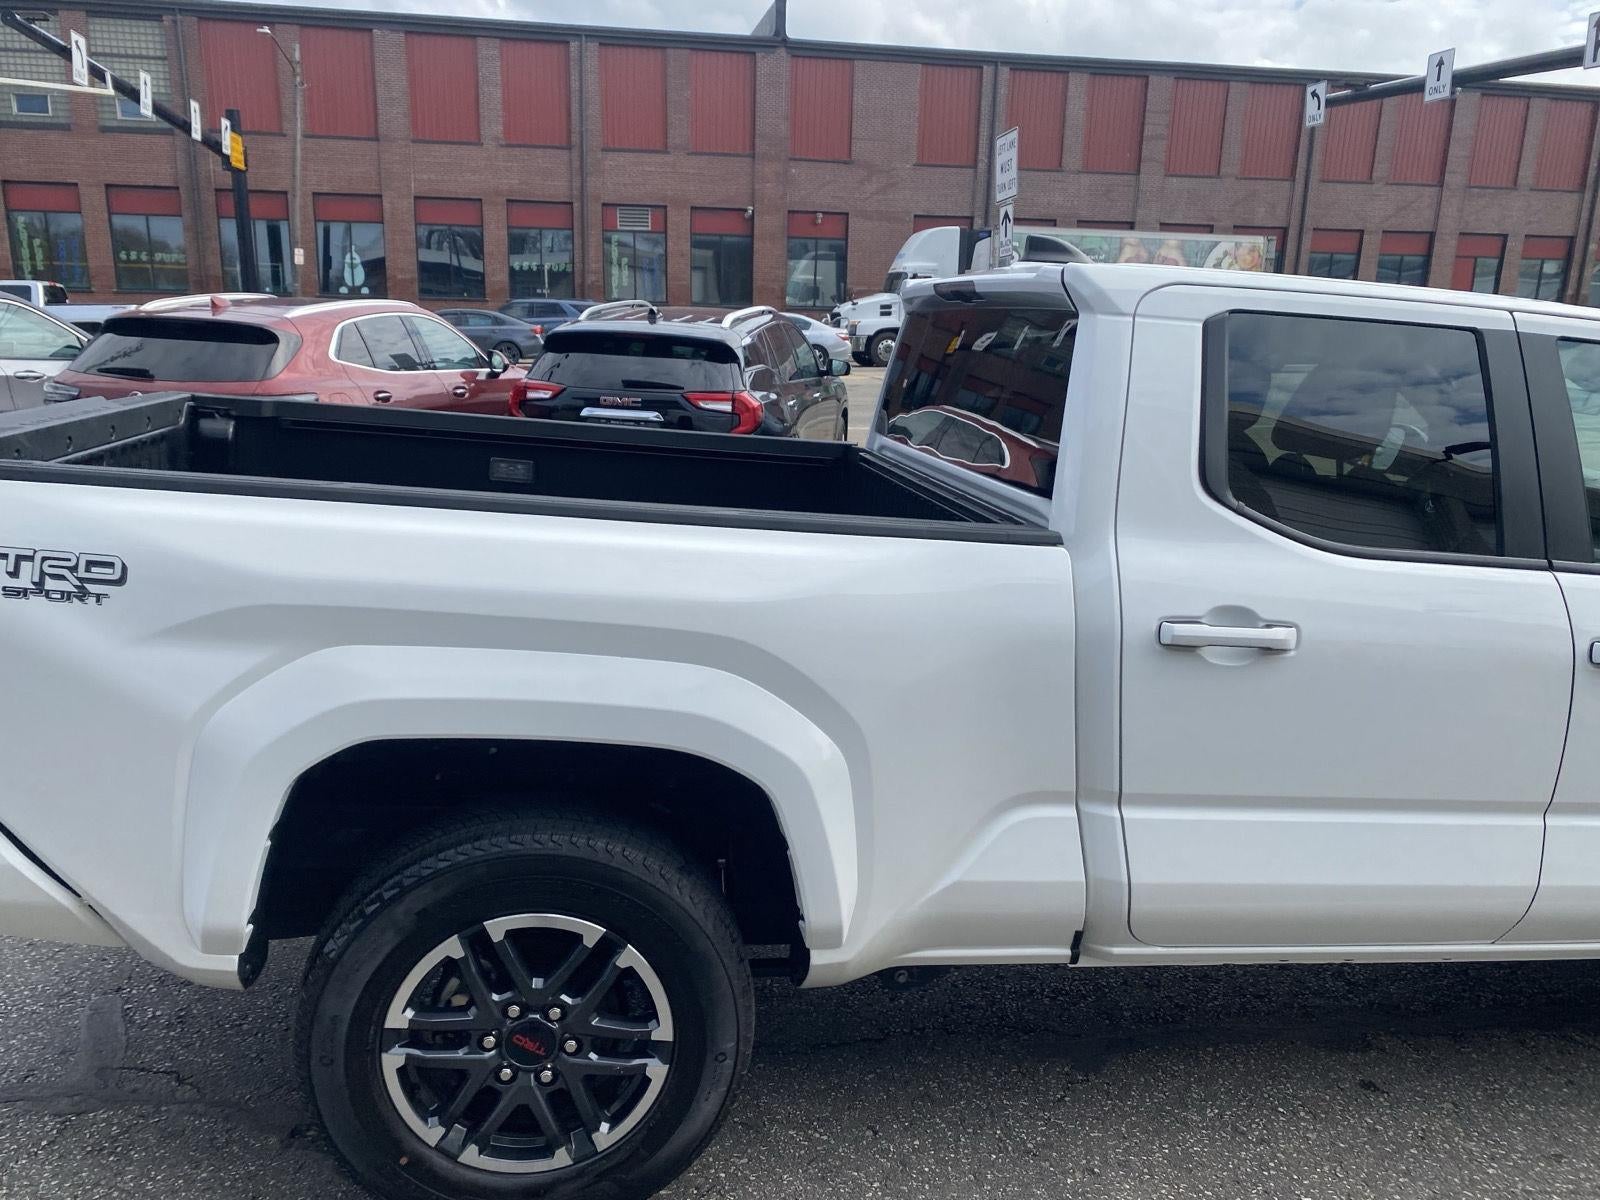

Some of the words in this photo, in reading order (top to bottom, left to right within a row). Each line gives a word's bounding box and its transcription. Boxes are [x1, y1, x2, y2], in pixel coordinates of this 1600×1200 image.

[1429, 84, 1446, 96] ONLY
[1308, 112, 1322, 123] ONLY
[1001, 158, 1012, 173] MUST
[600, 396, 641, 407] GMC
[0, 546, 128, 587] TRD
[1, 586, 110, 606] SPORT
